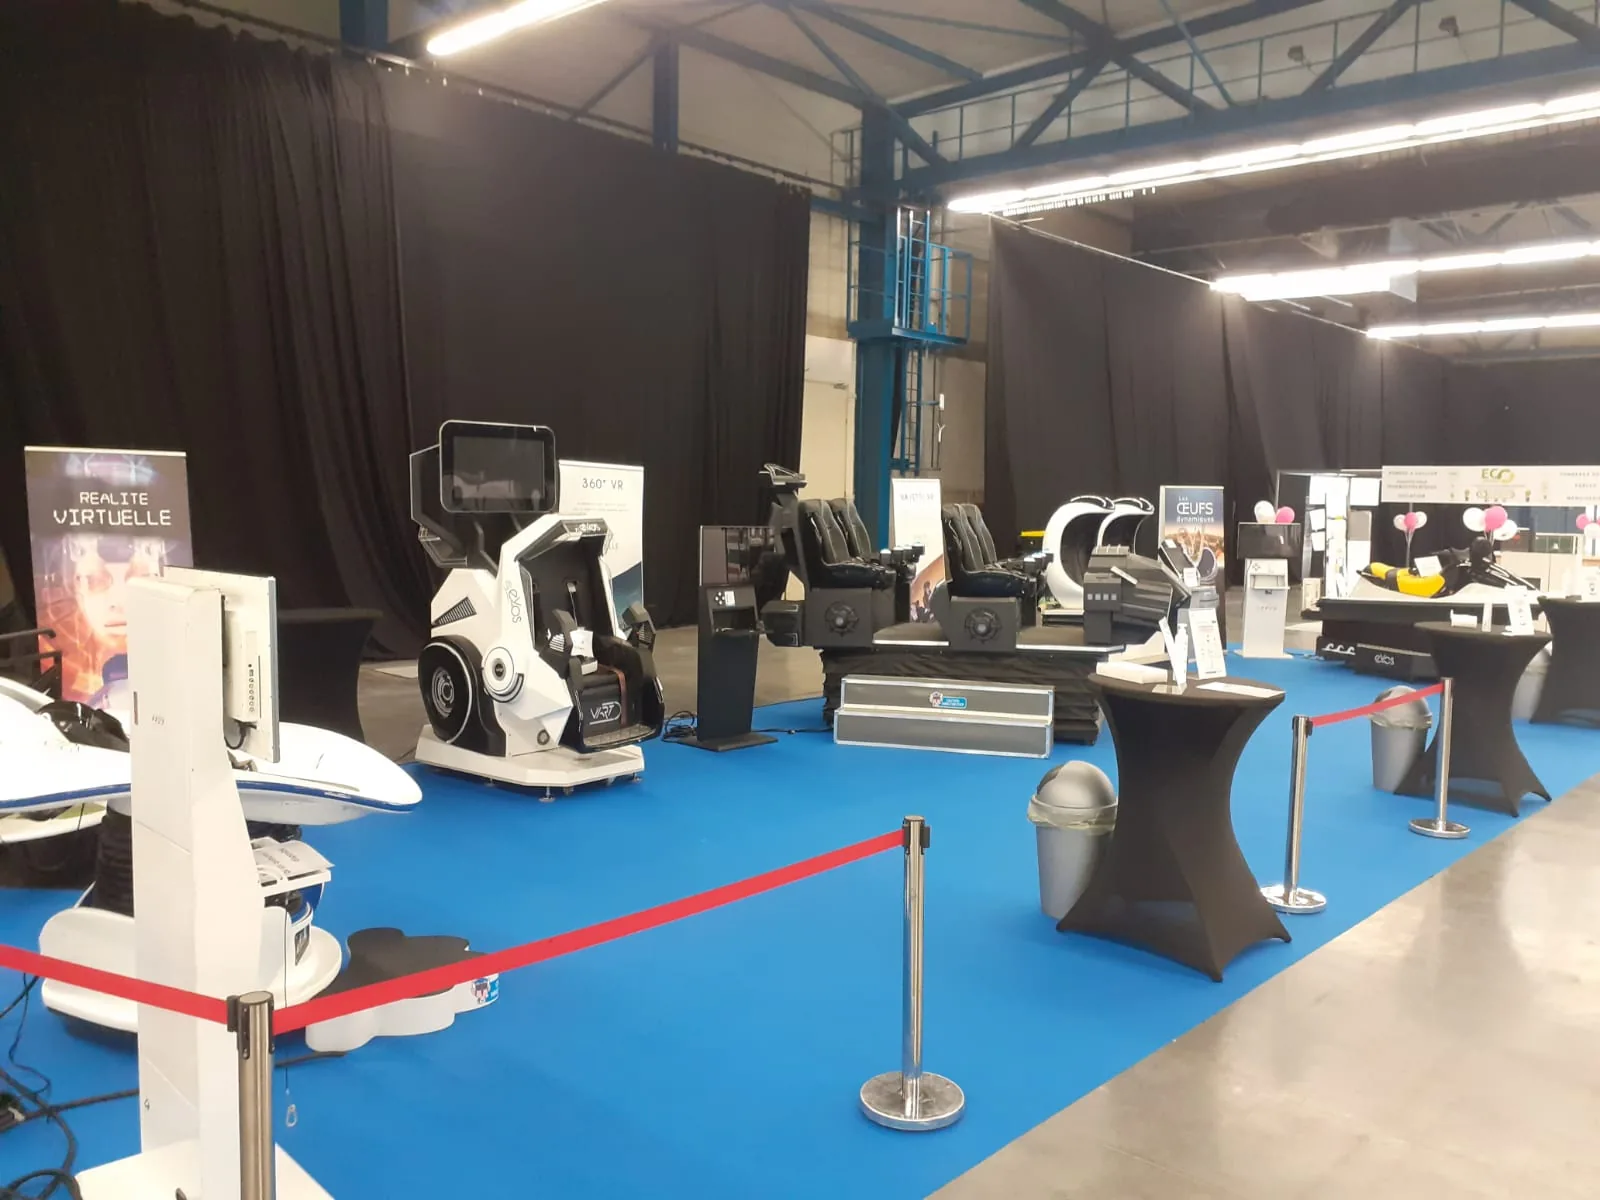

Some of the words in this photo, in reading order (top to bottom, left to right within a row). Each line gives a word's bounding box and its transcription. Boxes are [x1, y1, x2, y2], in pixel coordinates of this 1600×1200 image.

[611, 480, 624, 491] VR
[79, 491, 149, 506] REALITE
[1176, 501, 1214, 516] ŒUFS
[53, 508, 172, 526] VIRTUELLE
